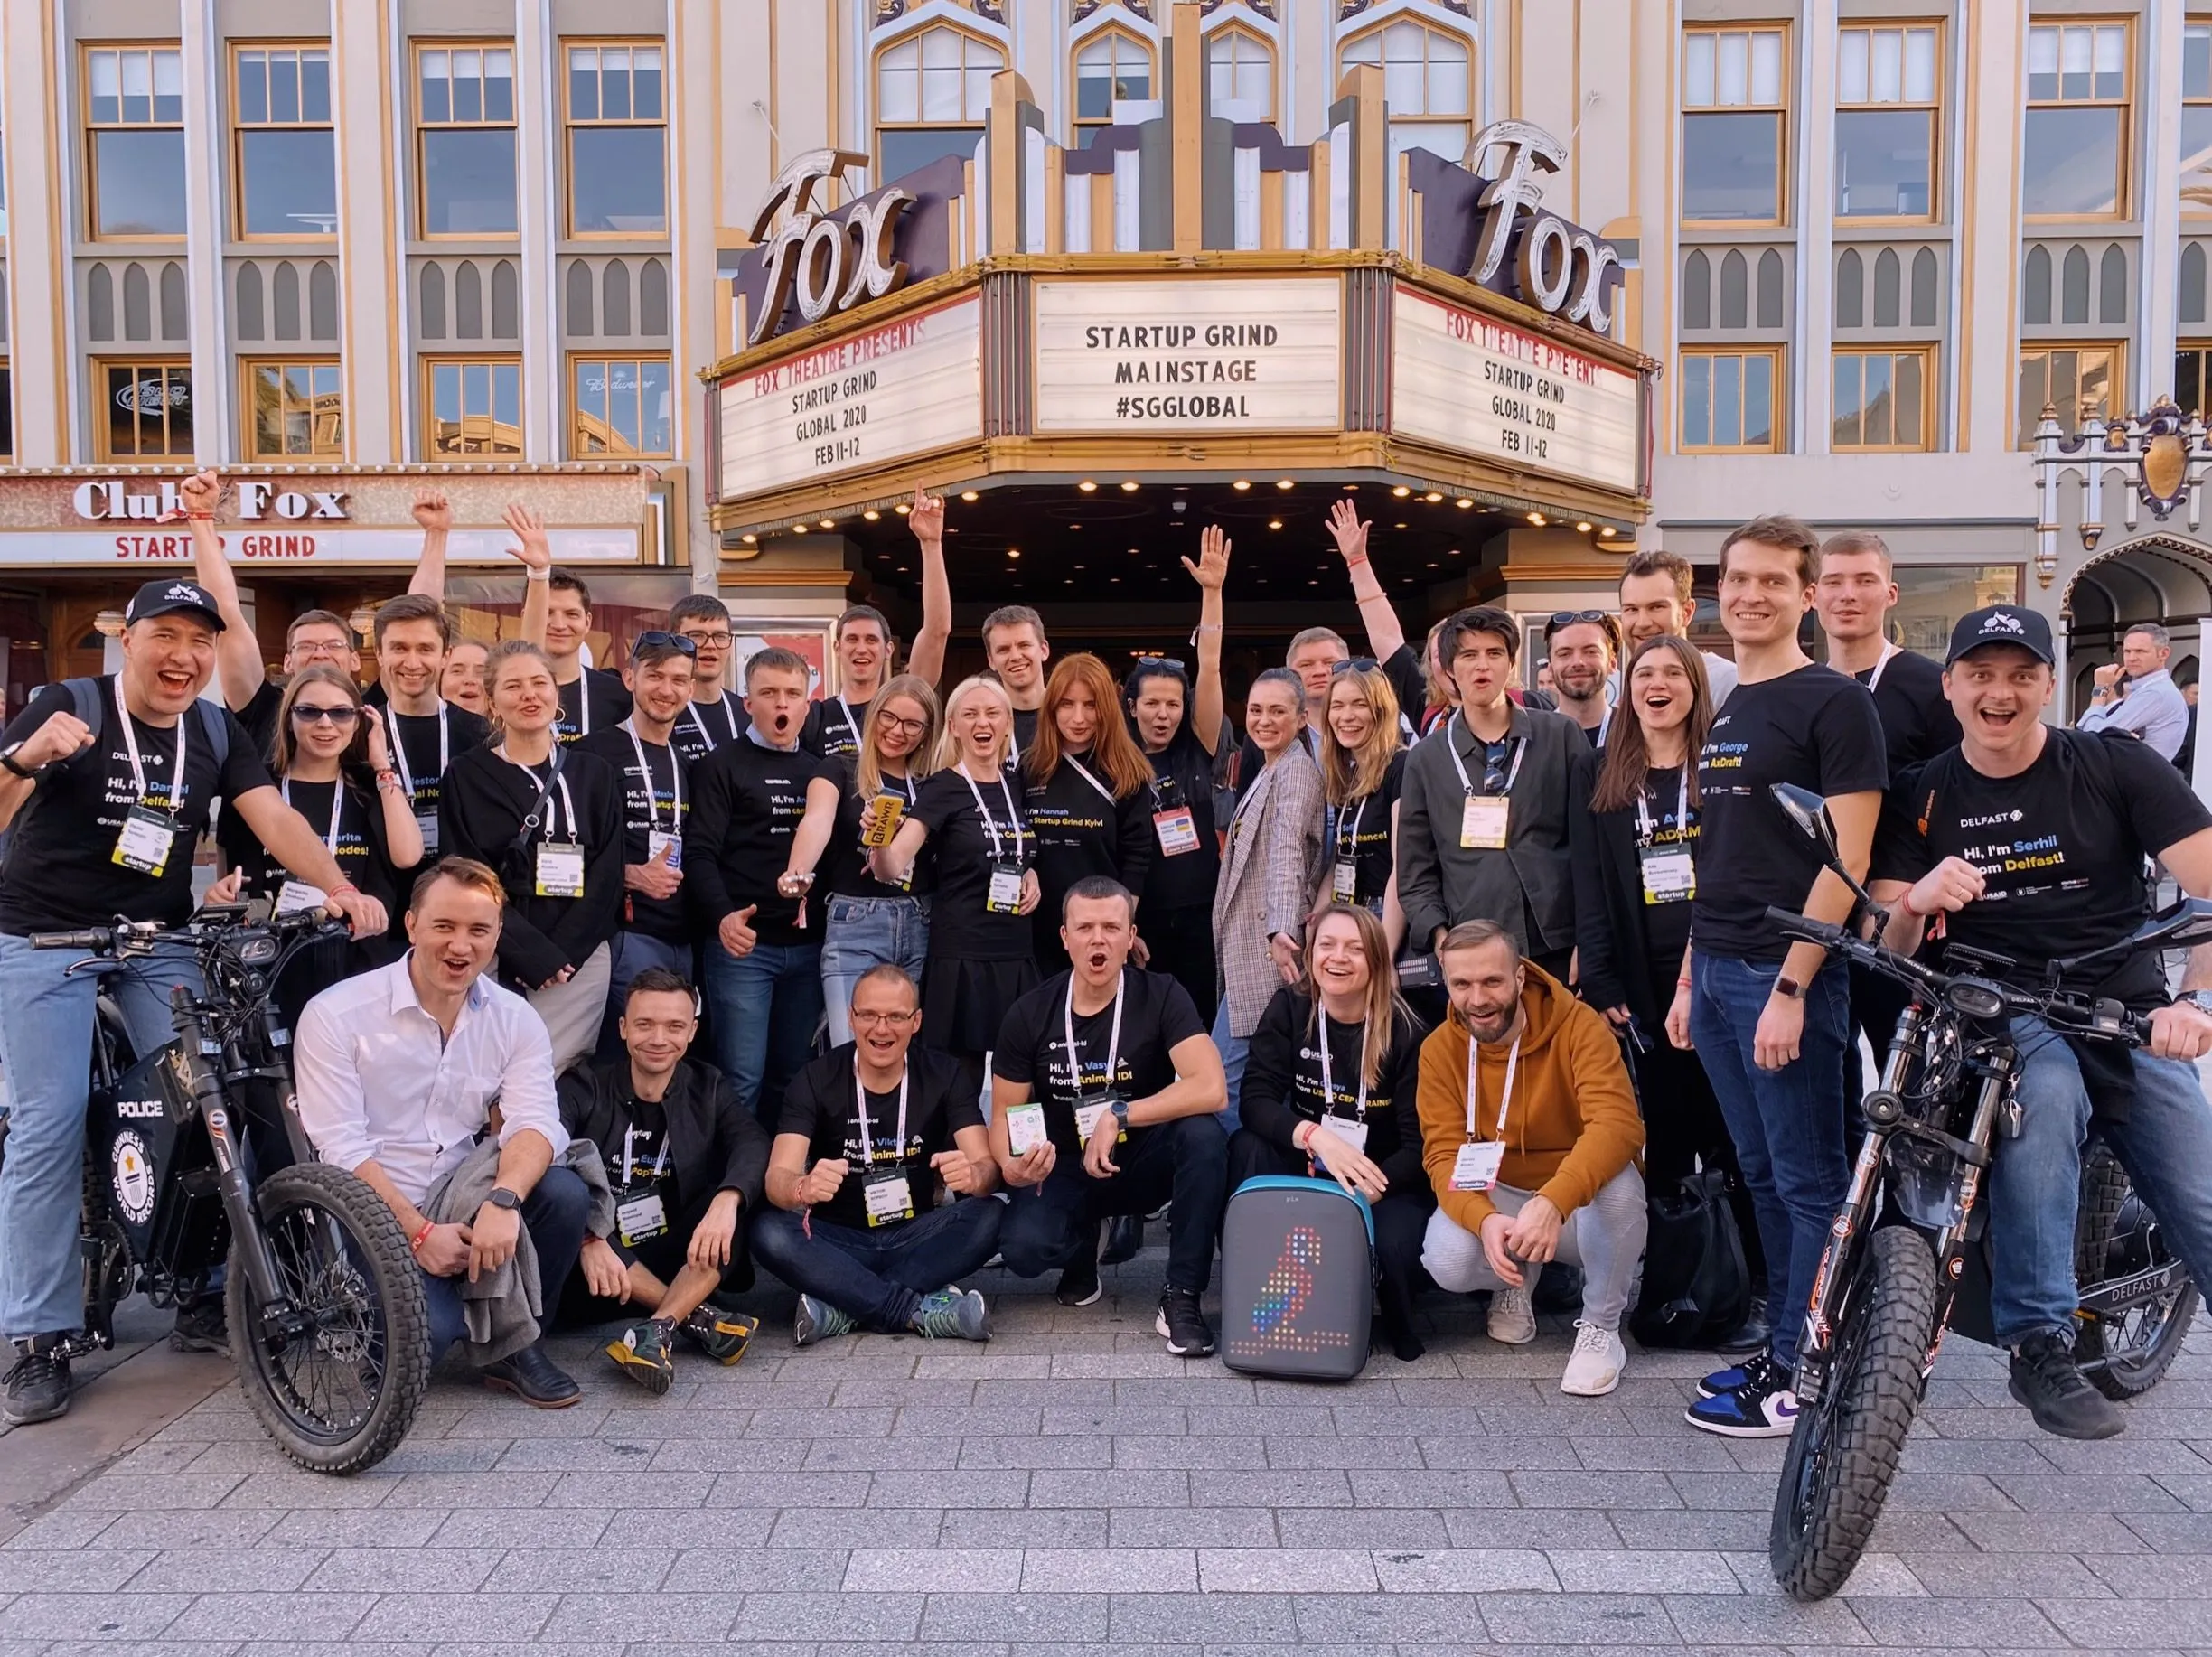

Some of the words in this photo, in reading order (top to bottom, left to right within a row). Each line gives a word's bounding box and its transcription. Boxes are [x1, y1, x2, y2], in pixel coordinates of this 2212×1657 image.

[1462, 118, 1622, 333] Fox
[748, 147, 917, 345] Fox
[1447, 311, 1475, 344] FOX
[1086, 325, 1196, 349] STARTUP
[1205, 324, 1278, 347] GRIND
[755, 371, 779, 398] FOX
[788, 345, 846, 387] THEATRE
[1115, 360, 1257, 384] MAINSTAGE
[1485, 360, 1532, 393] STARTUP
[1537, 379, 1564, 404] GRIND
[792, 383, 838, 415] STARTUP
[843, 371, 876, 396] GRIND
[1116, 395, 1250, 418] #SGGLOBAL
[1492, 395, 1532, 425] GLOBAL
[1536, 406, 1556, 432] 2020
[797, 417, 837, 442] GLOBAL
[843, 405, 867, 428] 2020
[815, 443, 834, 466] FEB
[837, 437, 859, 462] 11-12
[1502, 429, 1520, 451] FEB
[1526, 435, 1547, 459] 11-12
[237, 482, 348, 520] Fox
[867, 500, 879, 511] SAN
[879, 496, 902, 508] MATEO
[116, 536, 226, 558] START
[242, 535, 315, 557] GRIND
[1978, 626, 2016, 635] DELFAST
[1719, 742, 1748, 754] George
[112, 751, 153, 763] DELST
[1710, 756, 1743, 768] AxDraft!
[108, 777, 127, 791] Hi,
[150, 781, 190, 794] Danel
[105, 792, 134, 804] from
[138, 794, 185, 809] Delfa!
[627, 791, 640, 800] Hi,
[771, 795, 783, 803] Hi,
[783, 795, 795, 803] I'm
[627, 800, 648, 809] from
[773, 807, 791, 815] from
[876, 802, 894, 833] RAWR
[1034, 817, 1061, 826] Startup
[1062, 818, 1083, 826] Grind
[1635, 818, 1659, 831] Im
[1960, 812, 2009, 828] DELFAST
[1964, 847, 1985, 860] Hi,
[1988, 845, 2010, 857] I'm
[2013, 835, 2058, 853] Serhii
[125, 857, 152, 871] startup
[2005, 851, 2065, 872] Delfast!
[547, 886, 573, 894] startup
[1658, 890, 1685, 901] startup
[1049, 1063, 1064, 1074] Hi,
[1049, 1076, 1074, 1086] from
[1117, 1071, 1133, 1081] ID!
[1295, 1073, 1306, 1084] Hi,
[1307, 1077, 1318, 1086] I'm
[1296, 1082, 1311, 1093] from
[1338, 1094, 1354, 1103] CEP
[117, 1100, 164, 1118] POLICE
[111, 1130, 145, 1163] GUINNESS
[844, 1138, 858, 1149] Hi,
[876, 1137, 907, 1147] Viktr
[843, 1149, 865, 1160] from
[112, 1176, 136, 1222] WORLD
[136, 1165, 155, 1224] RECORDS
[879, 1212, 904, 1222] startup
[633, 1230, 658, 1241] startup
[2112, 1275, 2160, 1302] DELFAST
